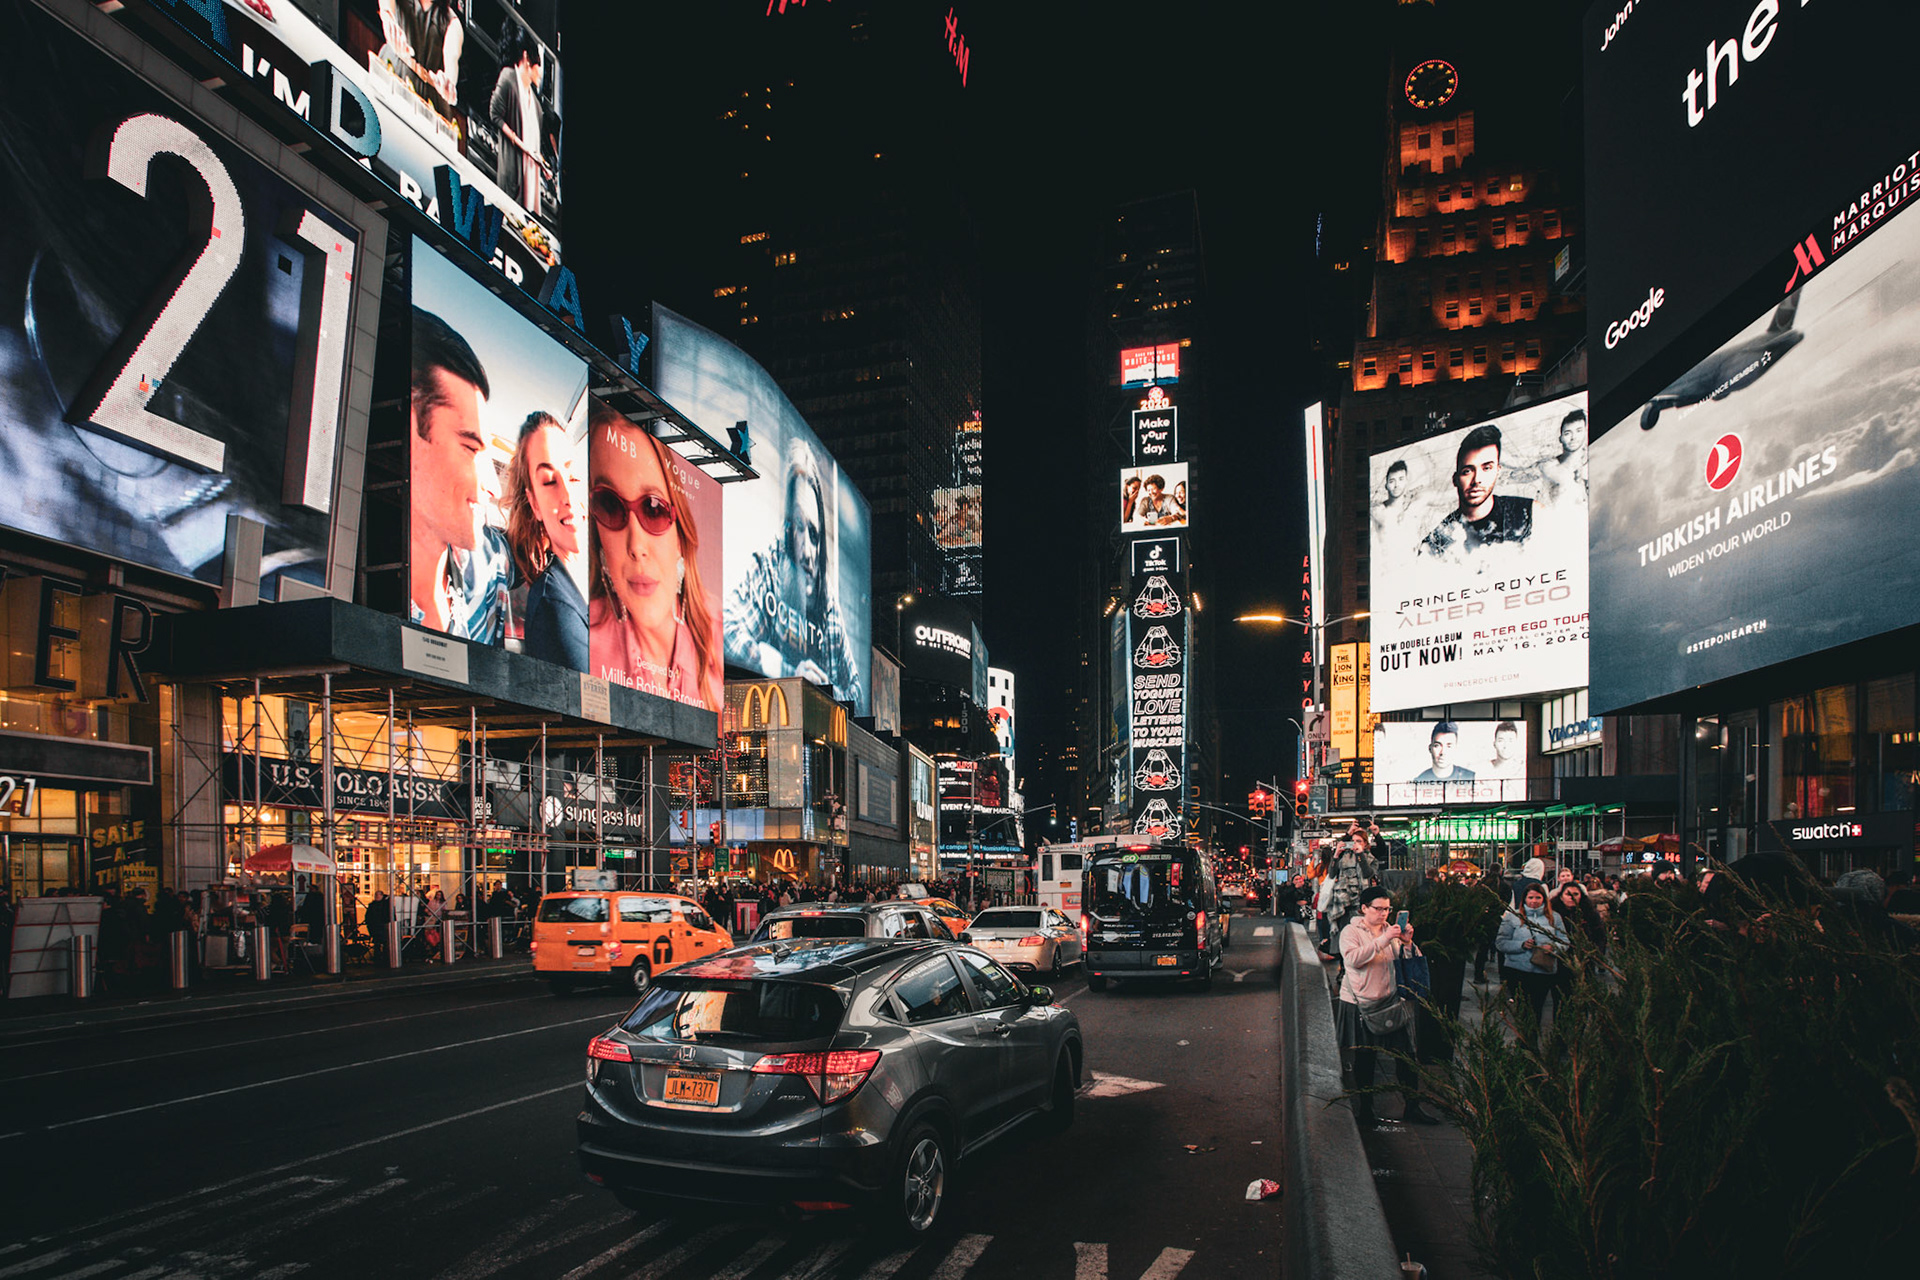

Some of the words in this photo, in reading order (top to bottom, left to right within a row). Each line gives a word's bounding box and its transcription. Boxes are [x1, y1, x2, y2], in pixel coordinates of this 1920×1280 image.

[1682, 0, 1779, 127] the
[242, 43, 310, 121] I'M
[88, 113, 356, 513] 21
[1604, 287, 1664, 350] Google
[1140, 397, 1170, 411] 2020
[1139, 417, 1170, 430] Make
[606, 425, 637, 459] MBB
[1141, 430, 1168, 445] your
[1638, 506, 1721, 567] TURKISH
[1726, 445, 1838, 525] AIRLINES
[1667, 551, 1705, 578] WIDEN
[1706, 535, 1740, 561] YOUR
[1741, 511, 1792, 545] WORLD
[1494, 569, 1567, 592] ROYCE
[1398, 601, 1485, 630] ALTER
[1503, 585, 1571, 610] EGO
[1473, 624, 1516, 640] ALTER
[1521, 619, 1548, 632] EGO
[1686, 618, 1768, 655] #STEPONEARTH
[1380, 643, 1398, 654] NEW
[1400, 636, 1432, 650] DOUBLE
[1434, 631, 1463, 646] ALBUM
[1473, 645, 1505, 657] MAY
[1336, 654, 1349, 662] THE
[1380, 650, 1411, 672] OUT
[1419, 643, 1463, 666] NOW!
[1335, 662, 1353, 674] LION
[601, 664, 634, 689] Millie
[636, 676, 671, 700] Bobby
[1133, 673, 1181, 690] SEND
[1333, 674, 1355, 686] KING
[1133, 688, 1183, 700] YOGURT
[1133, 699, 1182, 715] LOVE
[1132, 715, 1183, 726] LETTERS
[1132, 727, 1149, 739] TO
[1150, 726, 1183, 738] YOUR
[1132, 736, 1183, 749] MUSCLES
[270, 763, 315, 789] U.S.
[337, 795, 366, 807] SINCE
[92, 820, 145, 849] SALE
[1792, 822, 1852, 840] swatch
[692, 1081, 714, 1099] 7377
